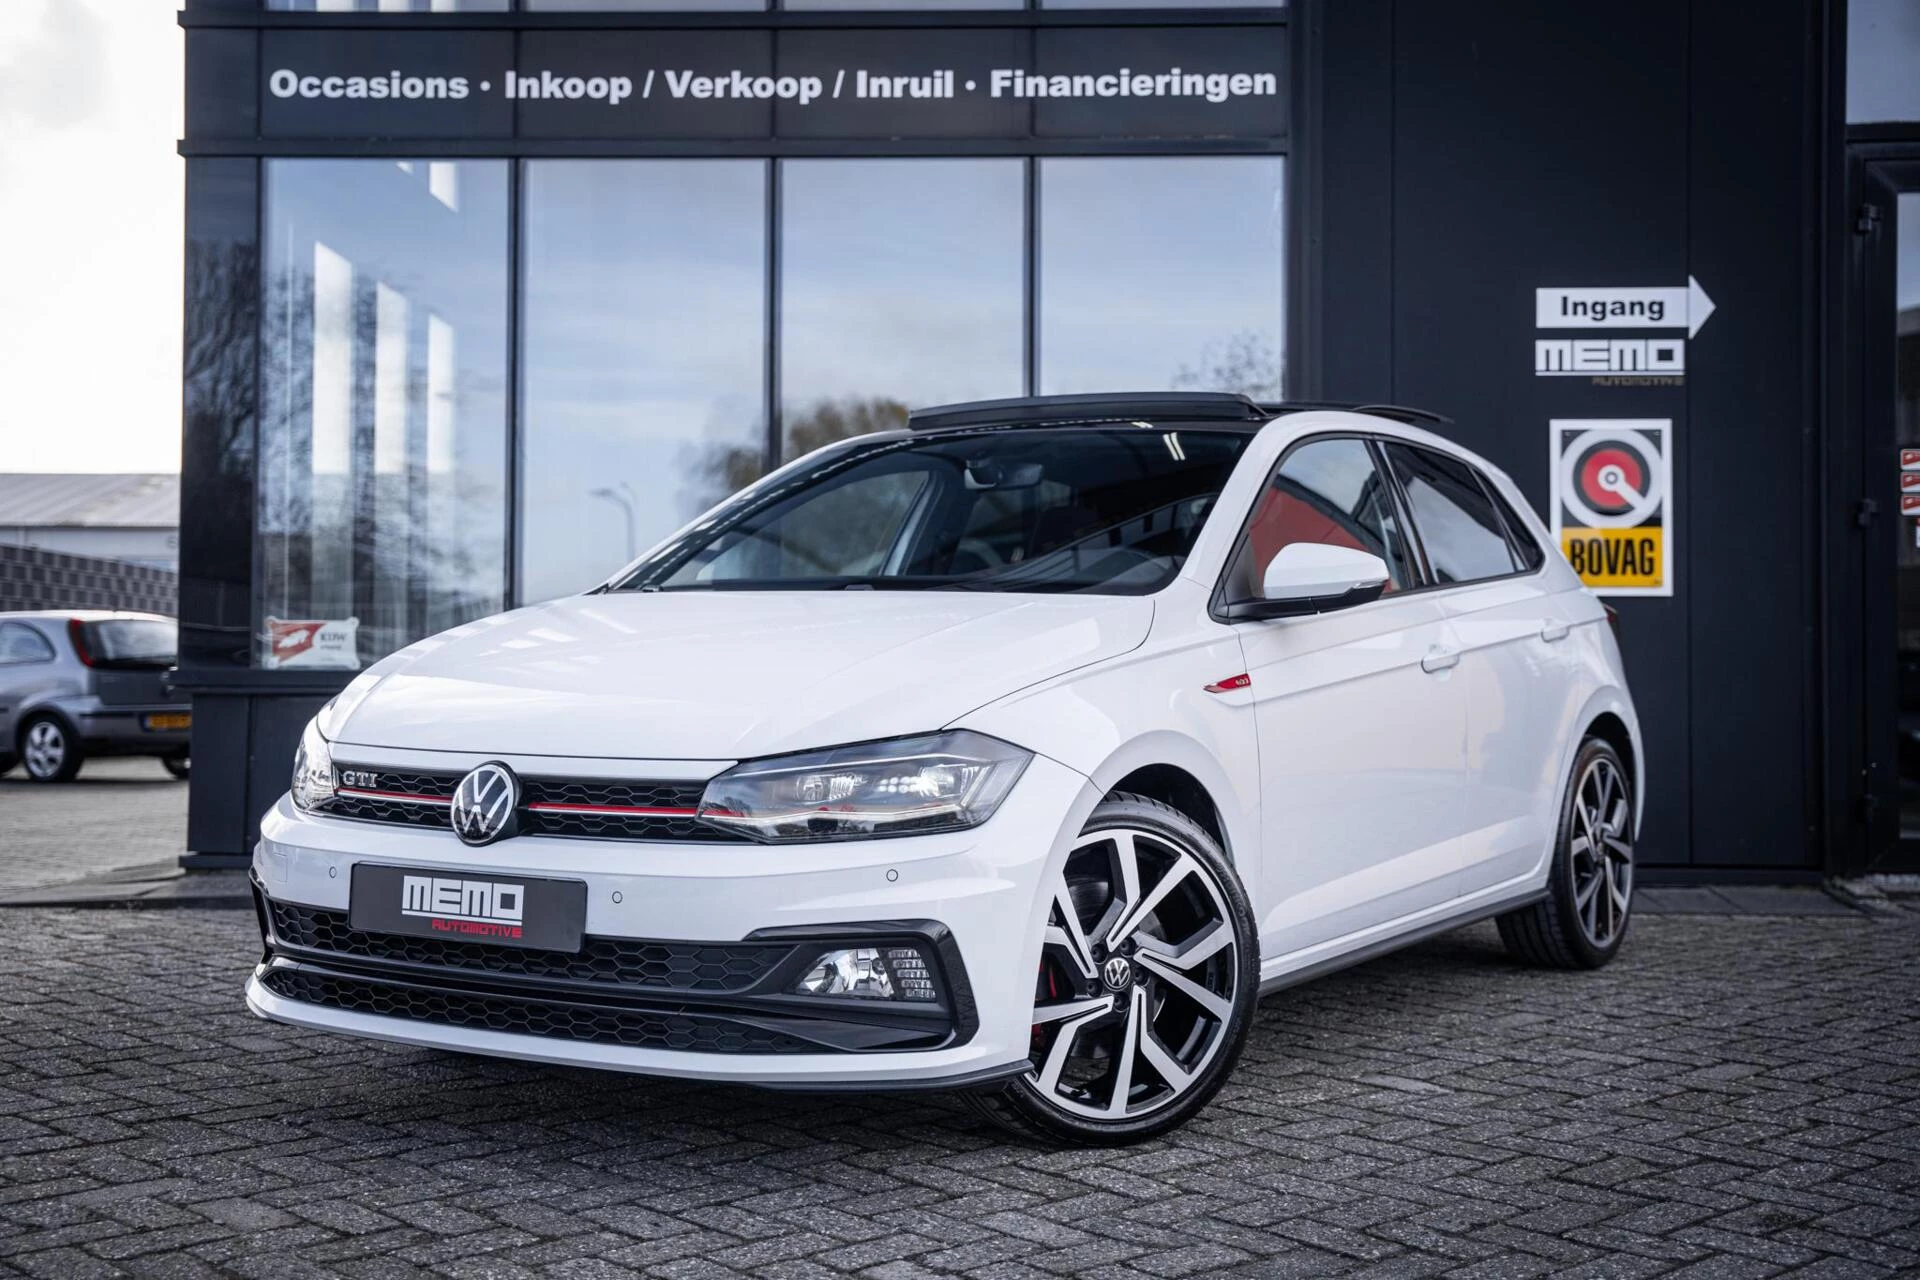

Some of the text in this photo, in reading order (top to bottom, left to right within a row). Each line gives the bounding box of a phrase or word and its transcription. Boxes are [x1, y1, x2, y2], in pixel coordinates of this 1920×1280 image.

[269, 68, 470, 99] Occasions
[505, 70, 633, 105] Inkoop
[664, 69, 823, 105] Verkoop
[856, 69, 954, 99] Inruil
[990, 67, 1277, 103] Financieringen
[1561, 296, 1665, 322] Ingang
[1535, 339, 1685, 372] MEMO
[1570, 537, 1655, 576] BOVAG
[342, 770, 378, 788] GTI
[402, 874, 525, 921] MEMO
[431, 918, 523, 938] AUTOMOTIVE
